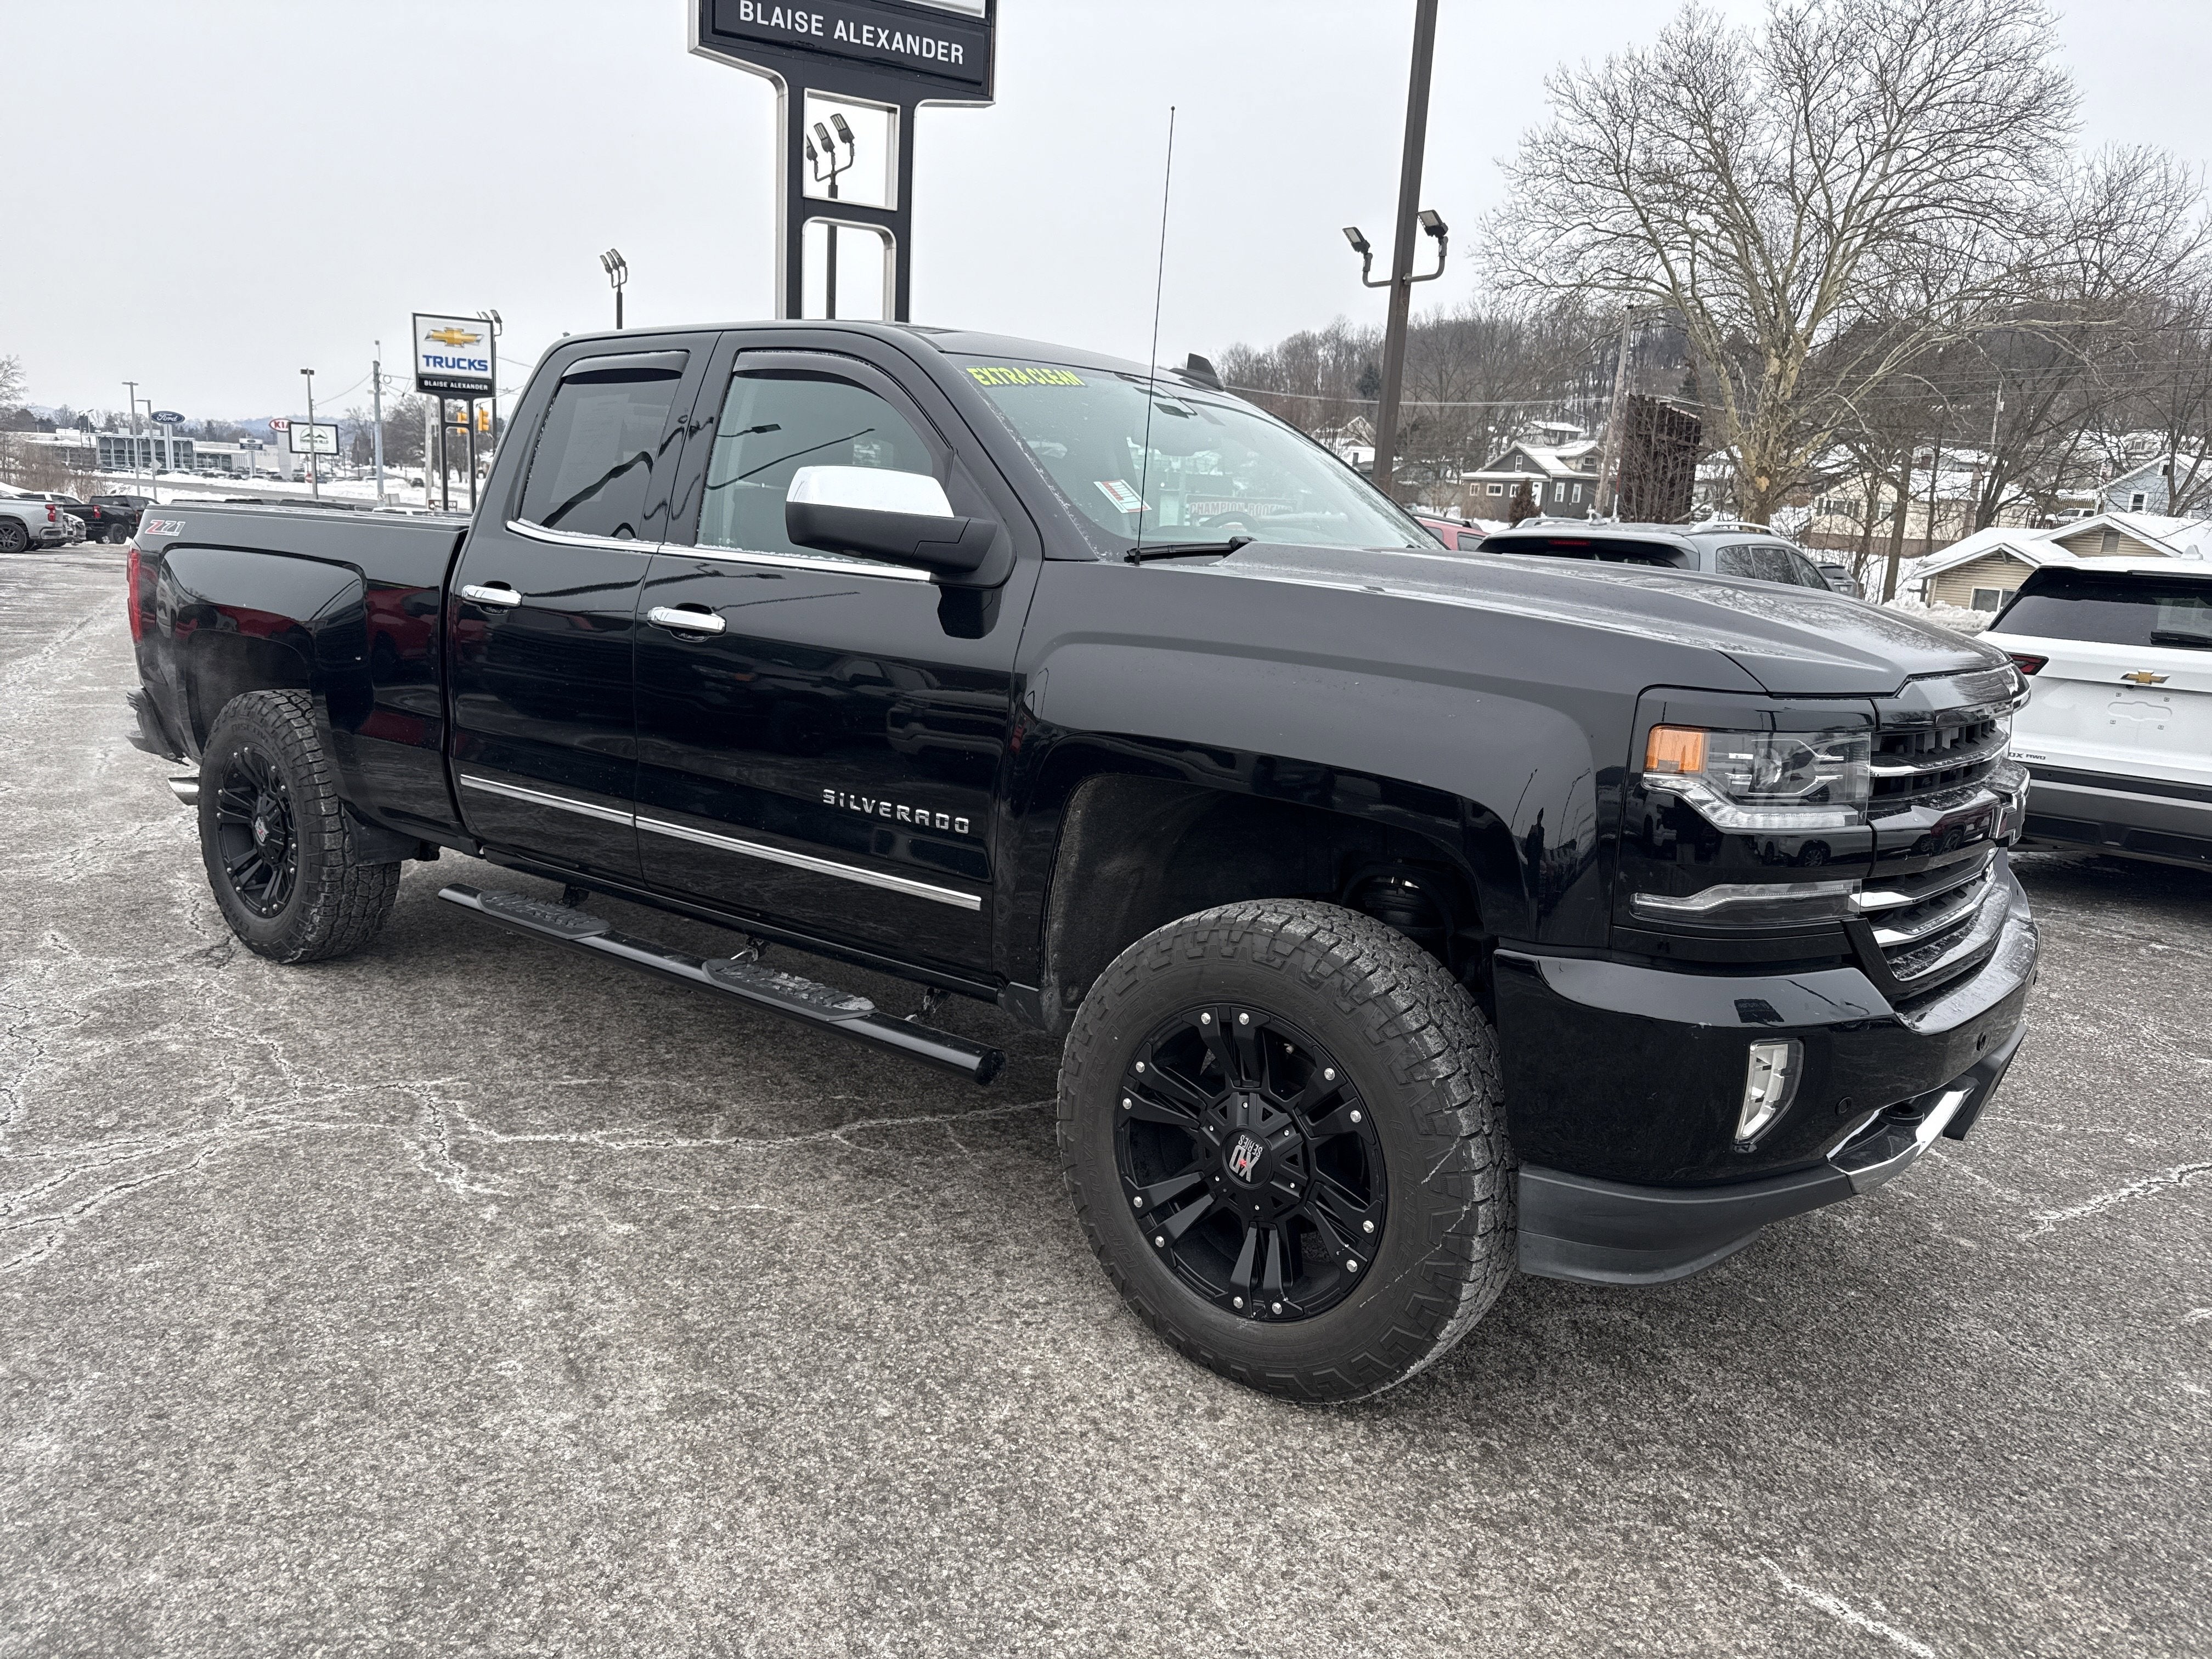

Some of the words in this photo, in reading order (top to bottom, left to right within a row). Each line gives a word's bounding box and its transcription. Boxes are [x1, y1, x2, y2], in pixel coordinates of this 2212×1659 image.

[740, 0, 824, 37] BLAISE
[833, 20, 964, 65] ALEXANDER
[422, 354, 488, 371] TRUCKS
[424, 380, 448, 388] BLAISE
[449, 381, 488, 391] ALEXANDER
[966, 367, 1035, 386] EXTRA
[1025, 368, 1086, 386] CLEAN
[156, 413, 178, 422] Ford
[144, 519, 186, 537] Z71
[823, 789, 969, 834] SILVERADO
[1238, 1135, 1263, 1159] SERIES
[1229, 1145, 1259, 1182] XD
